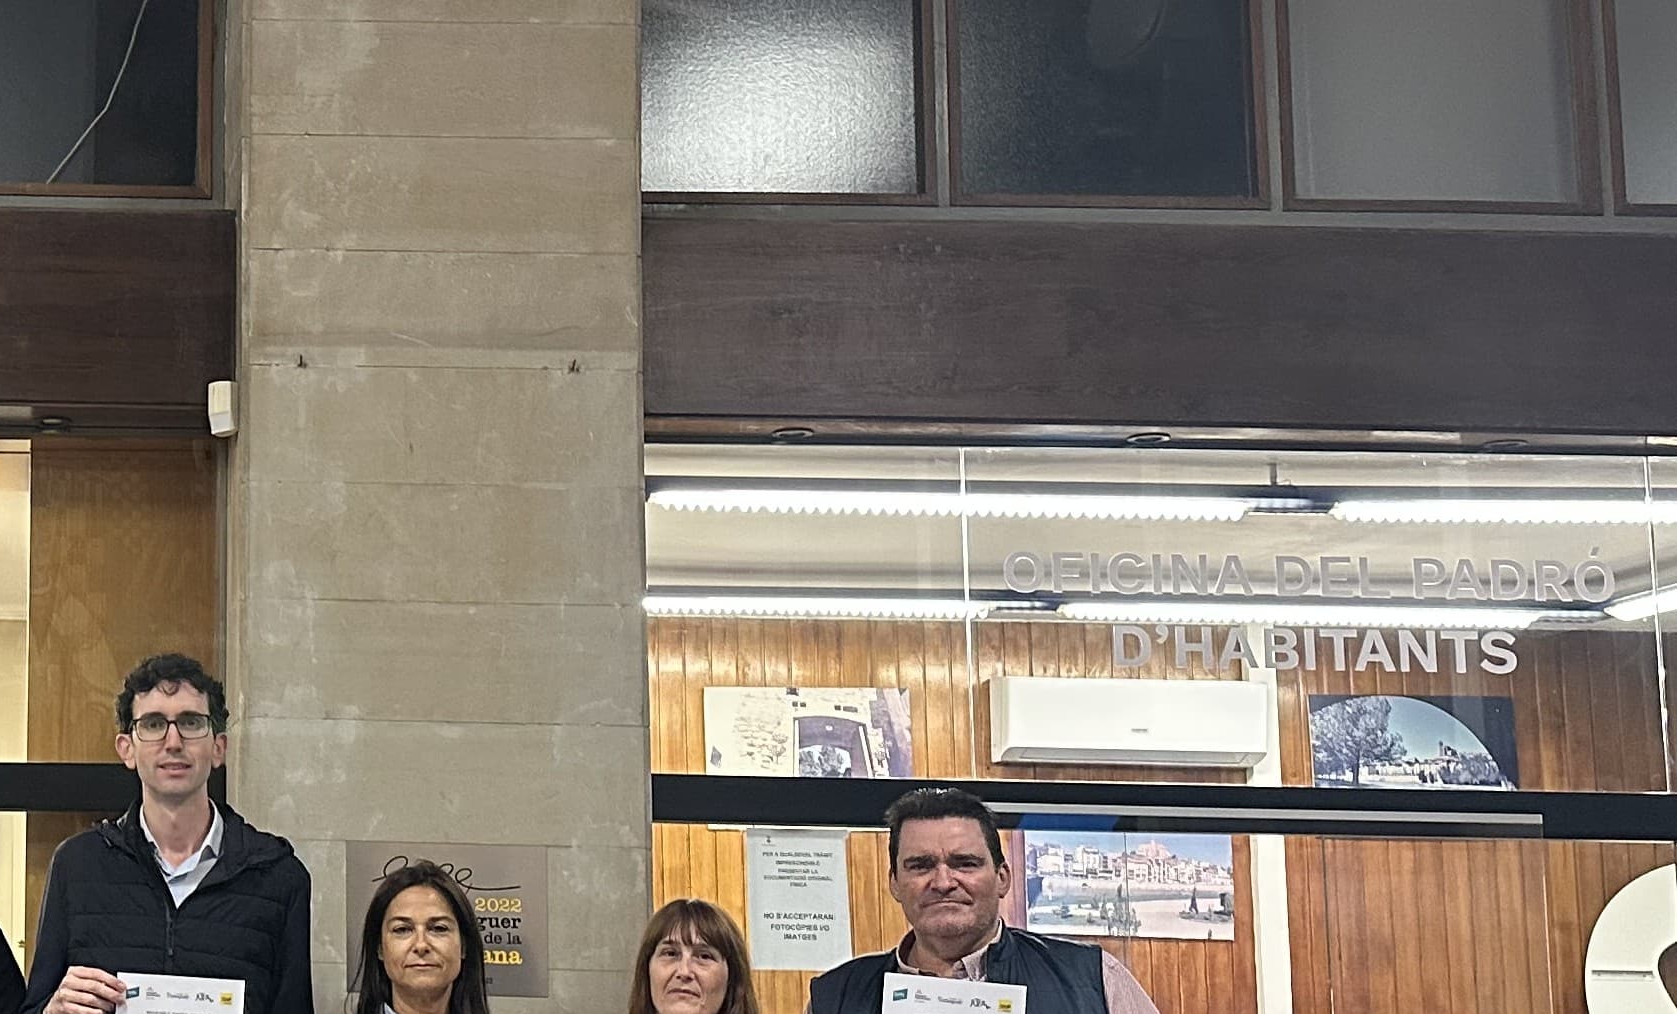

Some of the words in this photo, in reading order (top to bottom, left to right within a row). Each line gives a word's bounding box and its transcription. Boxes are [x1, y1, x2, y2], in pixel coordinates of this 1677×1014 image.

[1003, 550, 1255, 596] OFICINA
[1274, 554, 1391, 599] DEL
[1412, 547, 1615, 603] PADRÓ
[1112, 623, 1519, 676] D'HABITANTS
[474, 897, 522, 913] 2022
[476, 915, 522, 932] guer
[763, 912, 775, 920] NO
[484, 931, 503, 945] de
[506, 931, 522, 945] la
[483, 949, 523, 965] ana
